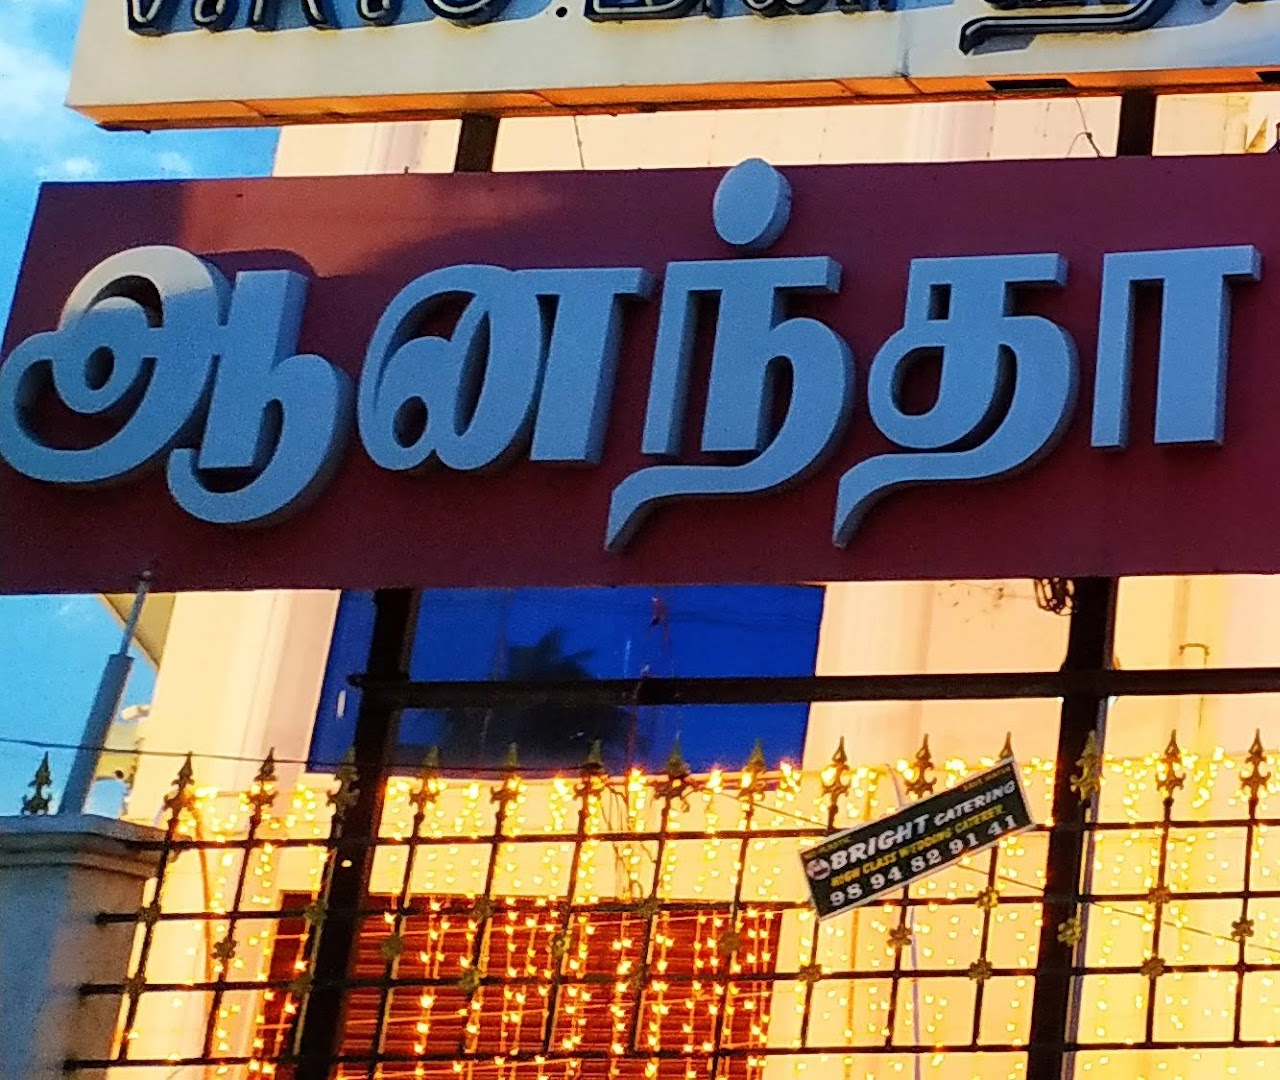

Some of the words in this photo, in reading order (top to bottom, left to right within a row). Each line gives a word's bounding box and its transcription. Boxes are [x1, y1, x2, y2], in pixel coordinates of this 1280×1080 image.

[0, 157, 1262, 552] ஆனந்தா
[830, 814, 929, 870] BRIGHT
[933, 780, 1015, 826] CATERING
[830, 883, 863, 906] 98
[870, 867, 903, 889] 94
[910, 848, 941, 872] 82
[949, 832, 979, 855] 91
[987, 815, 1017, 835] 41
[862, 851, 897, 874] CLASS
